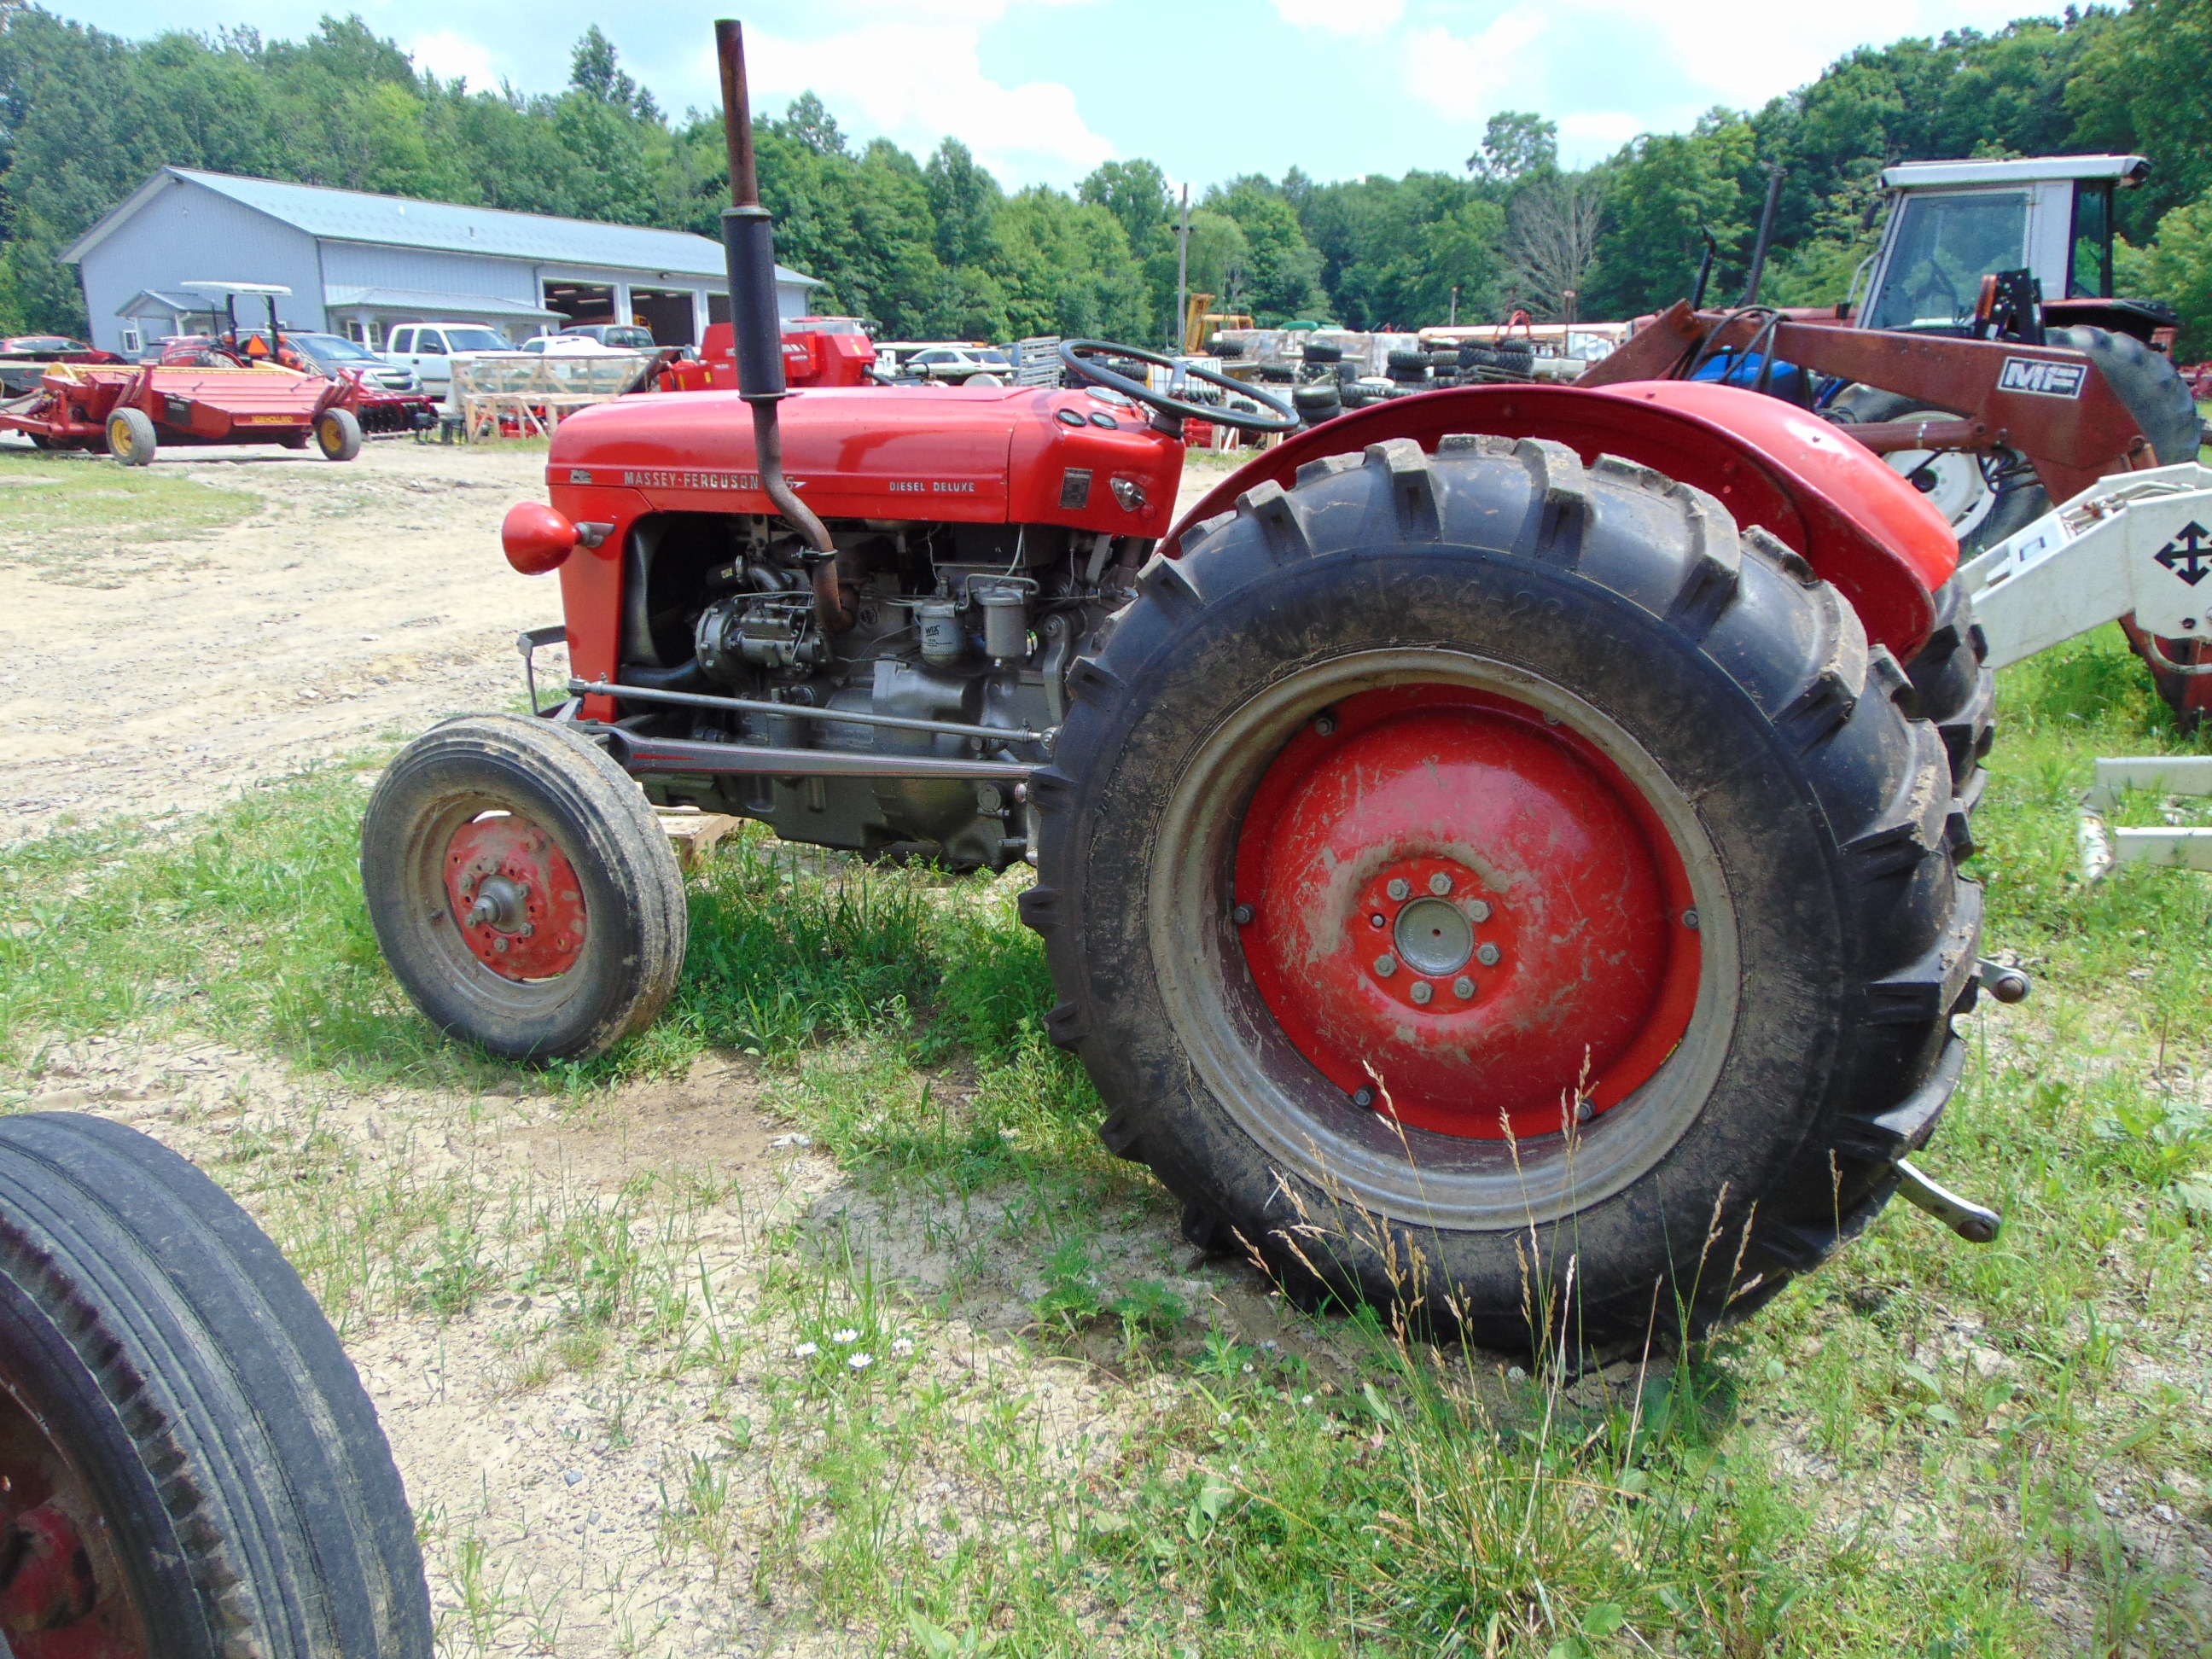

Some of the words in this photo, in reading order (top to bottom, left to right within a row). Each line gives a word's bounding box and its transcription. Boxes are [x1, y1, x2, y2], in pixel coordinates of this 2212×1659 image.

[2004, 362, 2080, 390] MF
[890, 482, 925, 492] DIESEL
[933, 481, 975, 492] DELUXE
[925, 625, 940, 634] WIX
